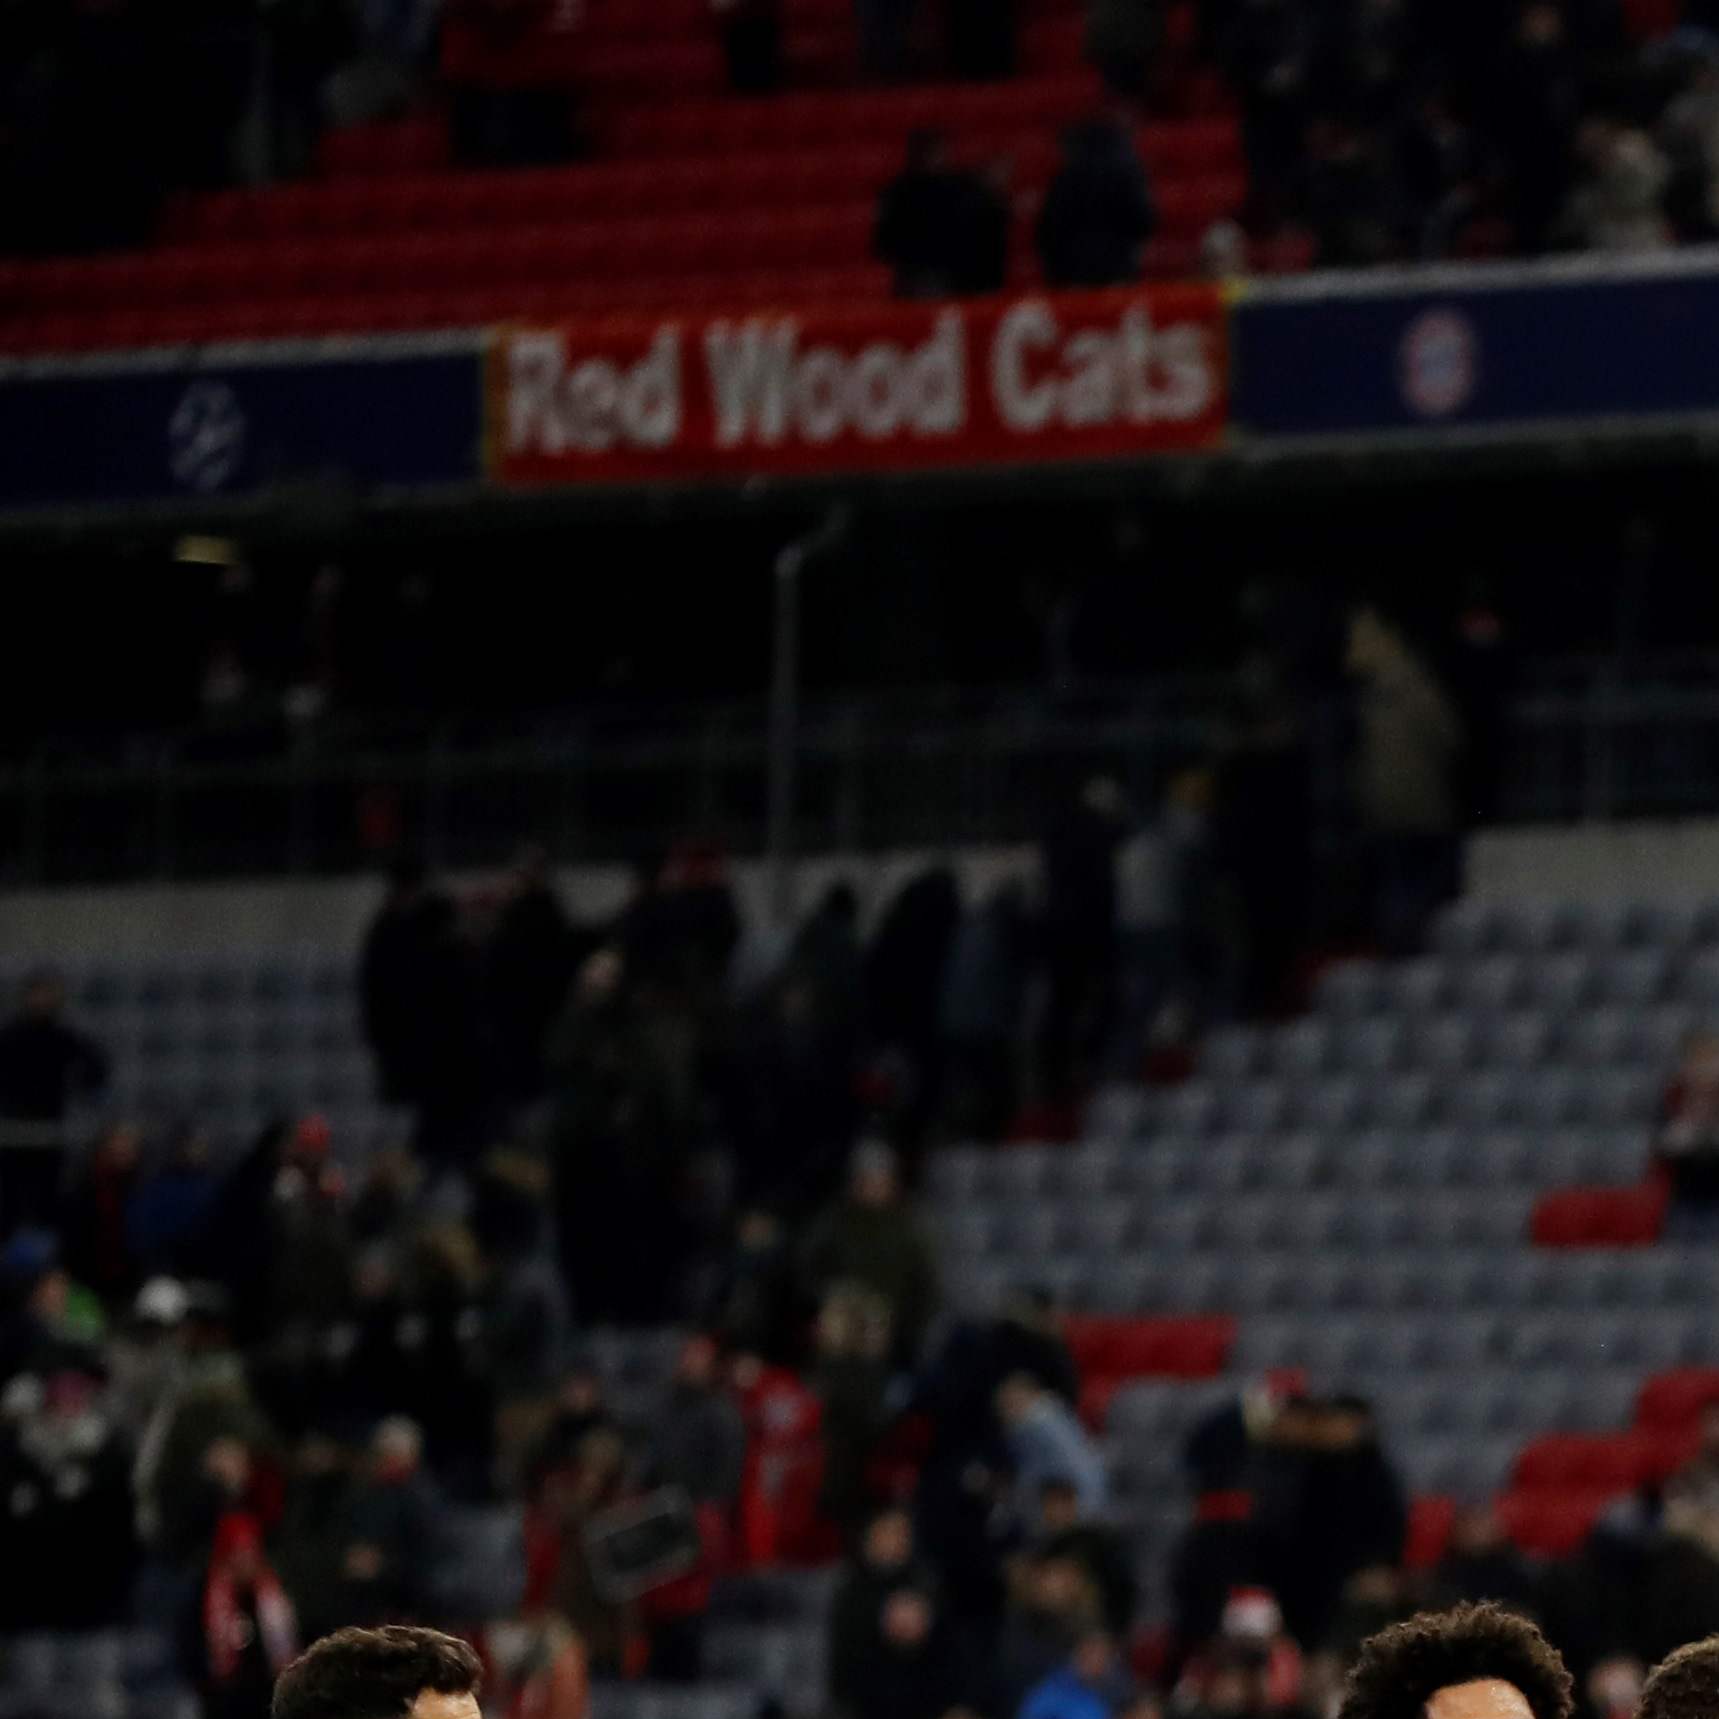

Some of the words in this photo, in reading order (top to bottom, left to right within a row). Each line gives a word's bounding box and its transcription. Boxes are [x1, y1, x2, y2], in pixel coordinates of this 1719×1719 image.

[505, 318, 682, 456] Red
[703, 304, 968, 450] Wood
[990, 295, 1216, 430] Cats
